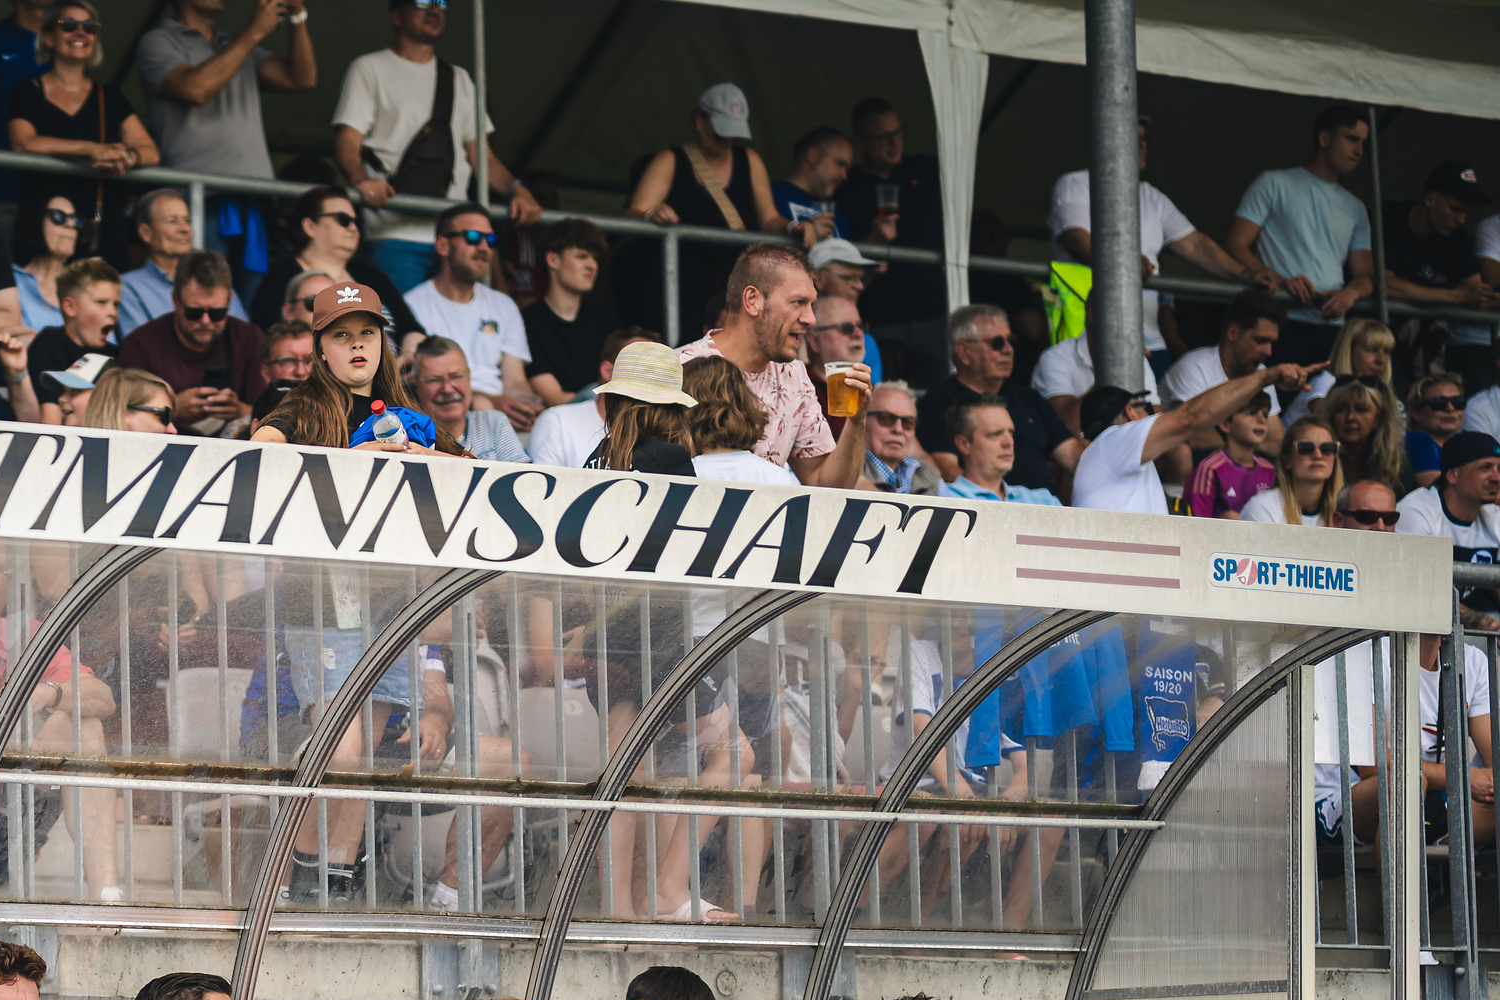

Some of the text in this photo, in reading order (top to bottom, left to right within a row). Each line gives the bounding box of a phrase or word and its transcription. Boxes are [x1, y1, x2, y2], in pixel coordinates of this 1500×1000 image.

[337, 296, 362, 304] adidas
[1213, 557, 1355, 592] SPORT-THIEME
[1145, 665, 1193, 683] SAISON
[1153, 680, 1182, 695] 19/20
